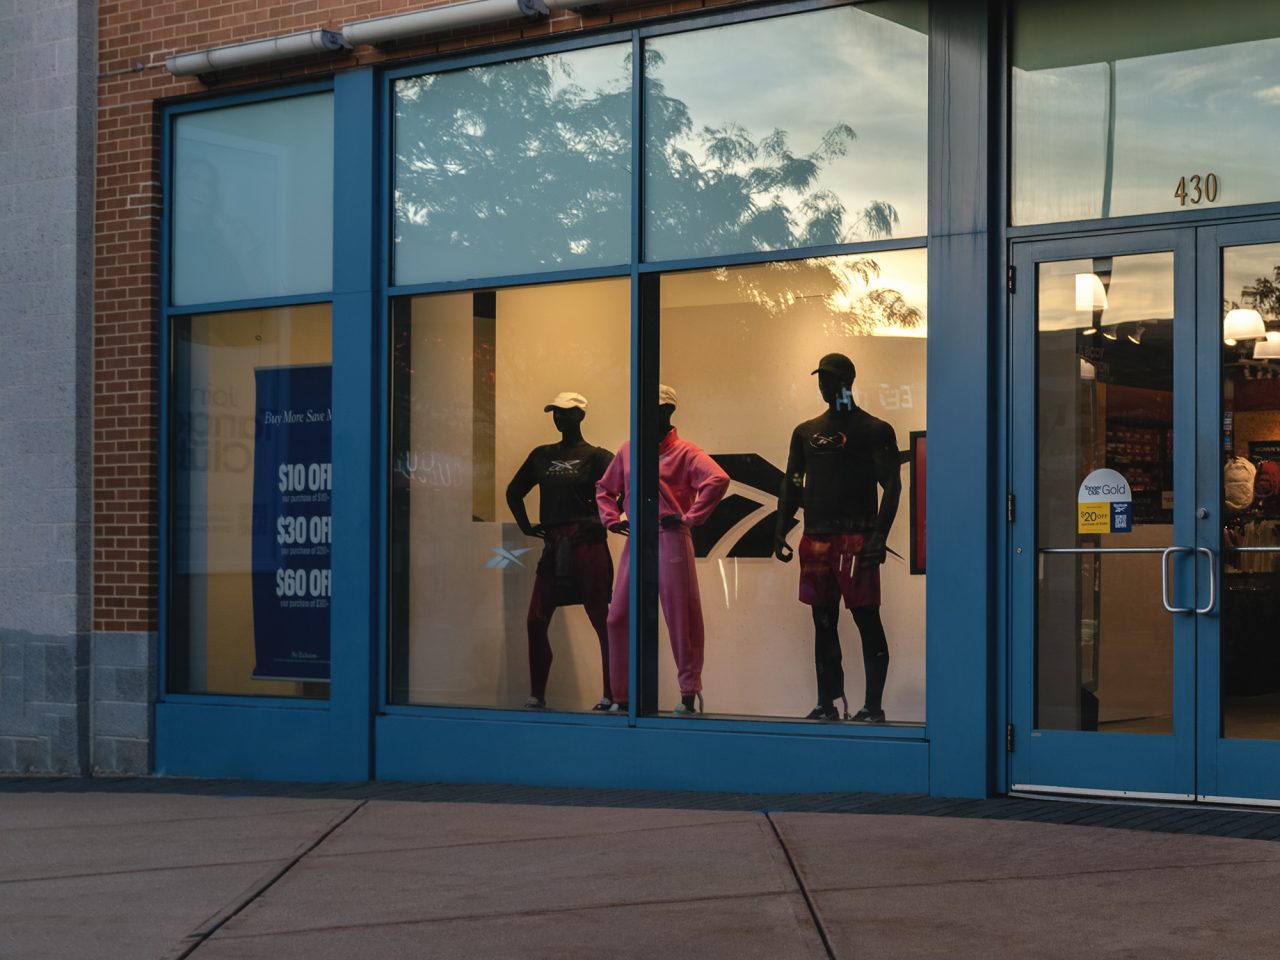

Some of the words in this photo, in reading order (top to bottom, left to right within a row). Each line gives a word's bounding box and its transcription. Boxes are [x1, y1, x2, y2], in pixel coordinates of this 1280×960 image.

[1174, 173, 1218, 206] 430
[264, 410, 283, 426] Buy
[283, 410, 304, 423] More
[305, 409, 326, 423] Save
[278, 462, 306, 493] $10
[1102, 484, 1126, 495] Gold
[276, 515, 306, 544] $30
[1081, 511, 1097, 522] $20
[275, 568, 306, 597] $60
